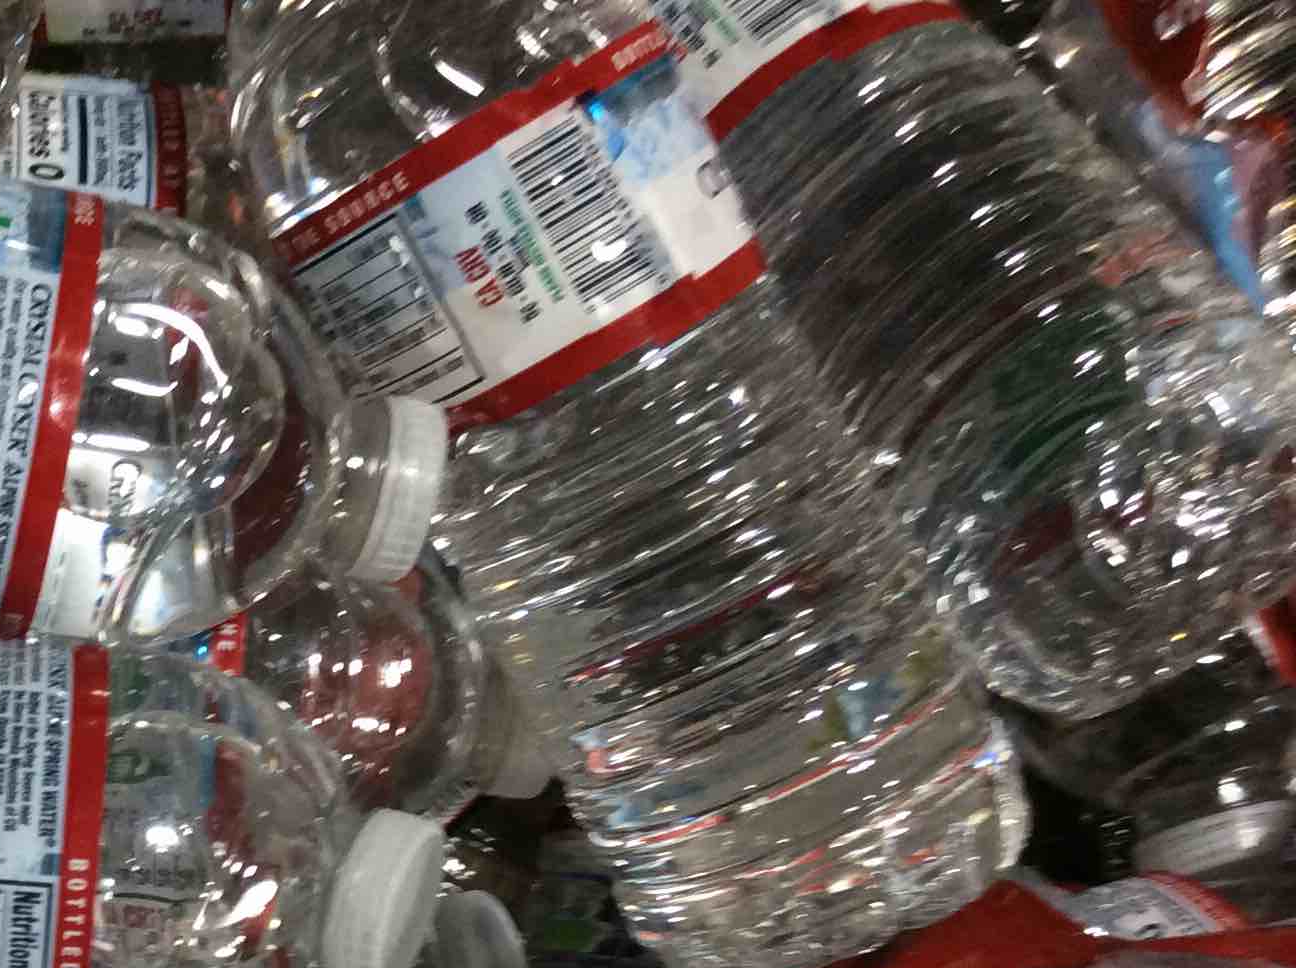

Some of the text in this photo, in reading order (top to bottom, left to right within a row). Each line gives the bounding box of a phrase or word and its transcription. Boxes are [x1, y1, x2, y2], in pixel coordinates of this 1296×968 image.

[469, 276, 506, 311] CA
[42, 739, 63, 788] SPRING
[38, 789, 60, 839] WATER
